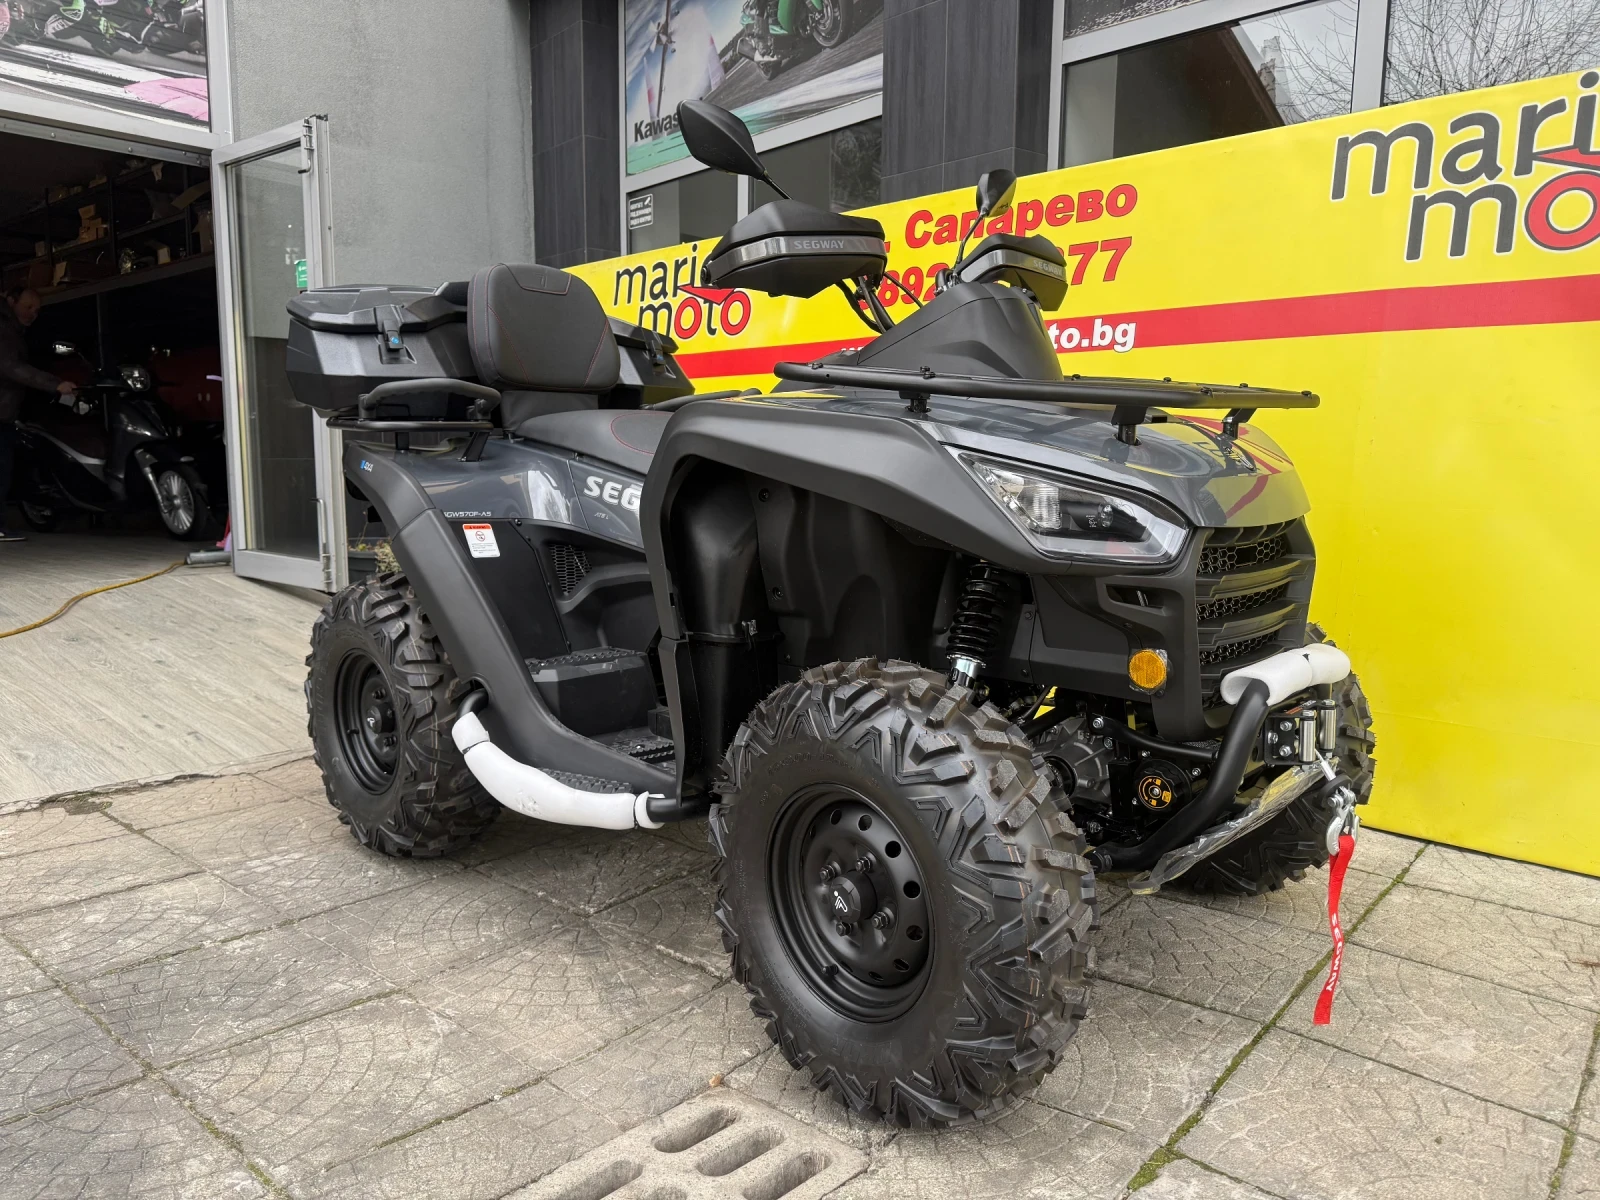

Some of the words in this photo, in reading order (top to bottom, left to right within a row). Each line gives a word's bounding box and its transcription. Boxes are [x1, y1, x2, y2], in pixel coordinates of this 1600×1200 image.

[634, 112, 679, 143] Kawas
[1331, 71, 1600, 200] mari
[905, 183, 1138, 249] Сапарево
[1405, 170, 1600, 261] mo
[793, 240, 845, 250] SEGWAY
[1033, 259, 1064, 277] SEGWAY
[613, 243, 712, 306] mari
[638, 290, 752, 340] moto
[583, 475, 641, 512] SEG
[1325, 912, 1343, 992] SEGWAY
